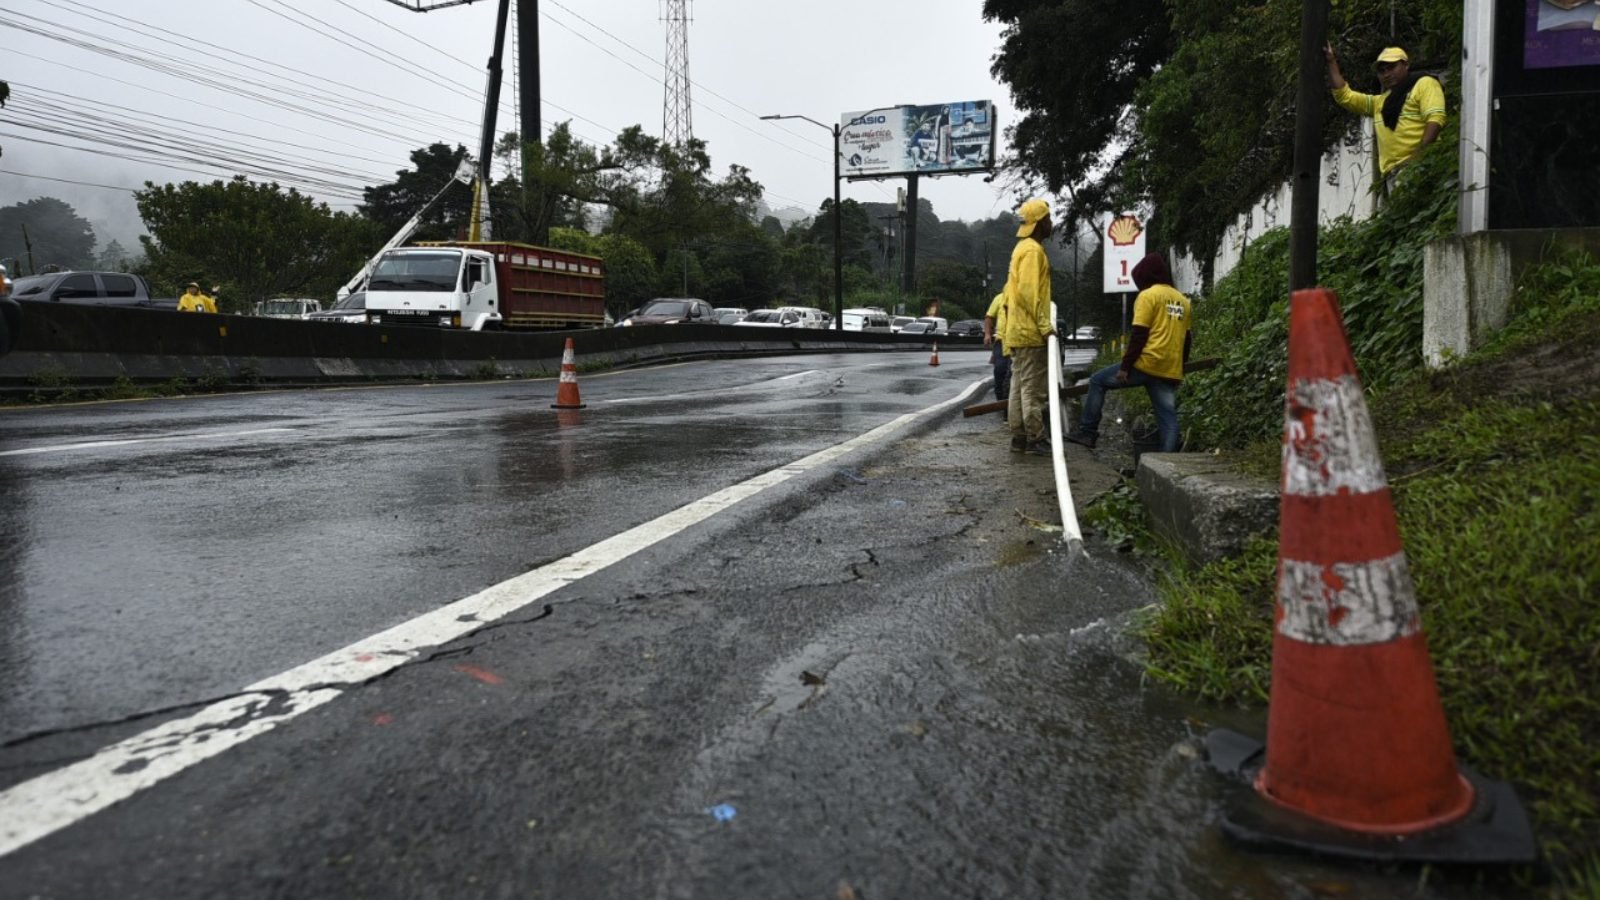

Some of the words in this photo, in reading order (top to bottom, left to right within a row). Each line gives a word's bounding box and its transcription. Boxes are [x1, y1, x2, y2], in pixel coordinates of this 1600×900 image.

[850, 115, 886, 125] CASIO
[1120, 260, 1127, 276] 1
[1117, 277, 1130, 285] km
